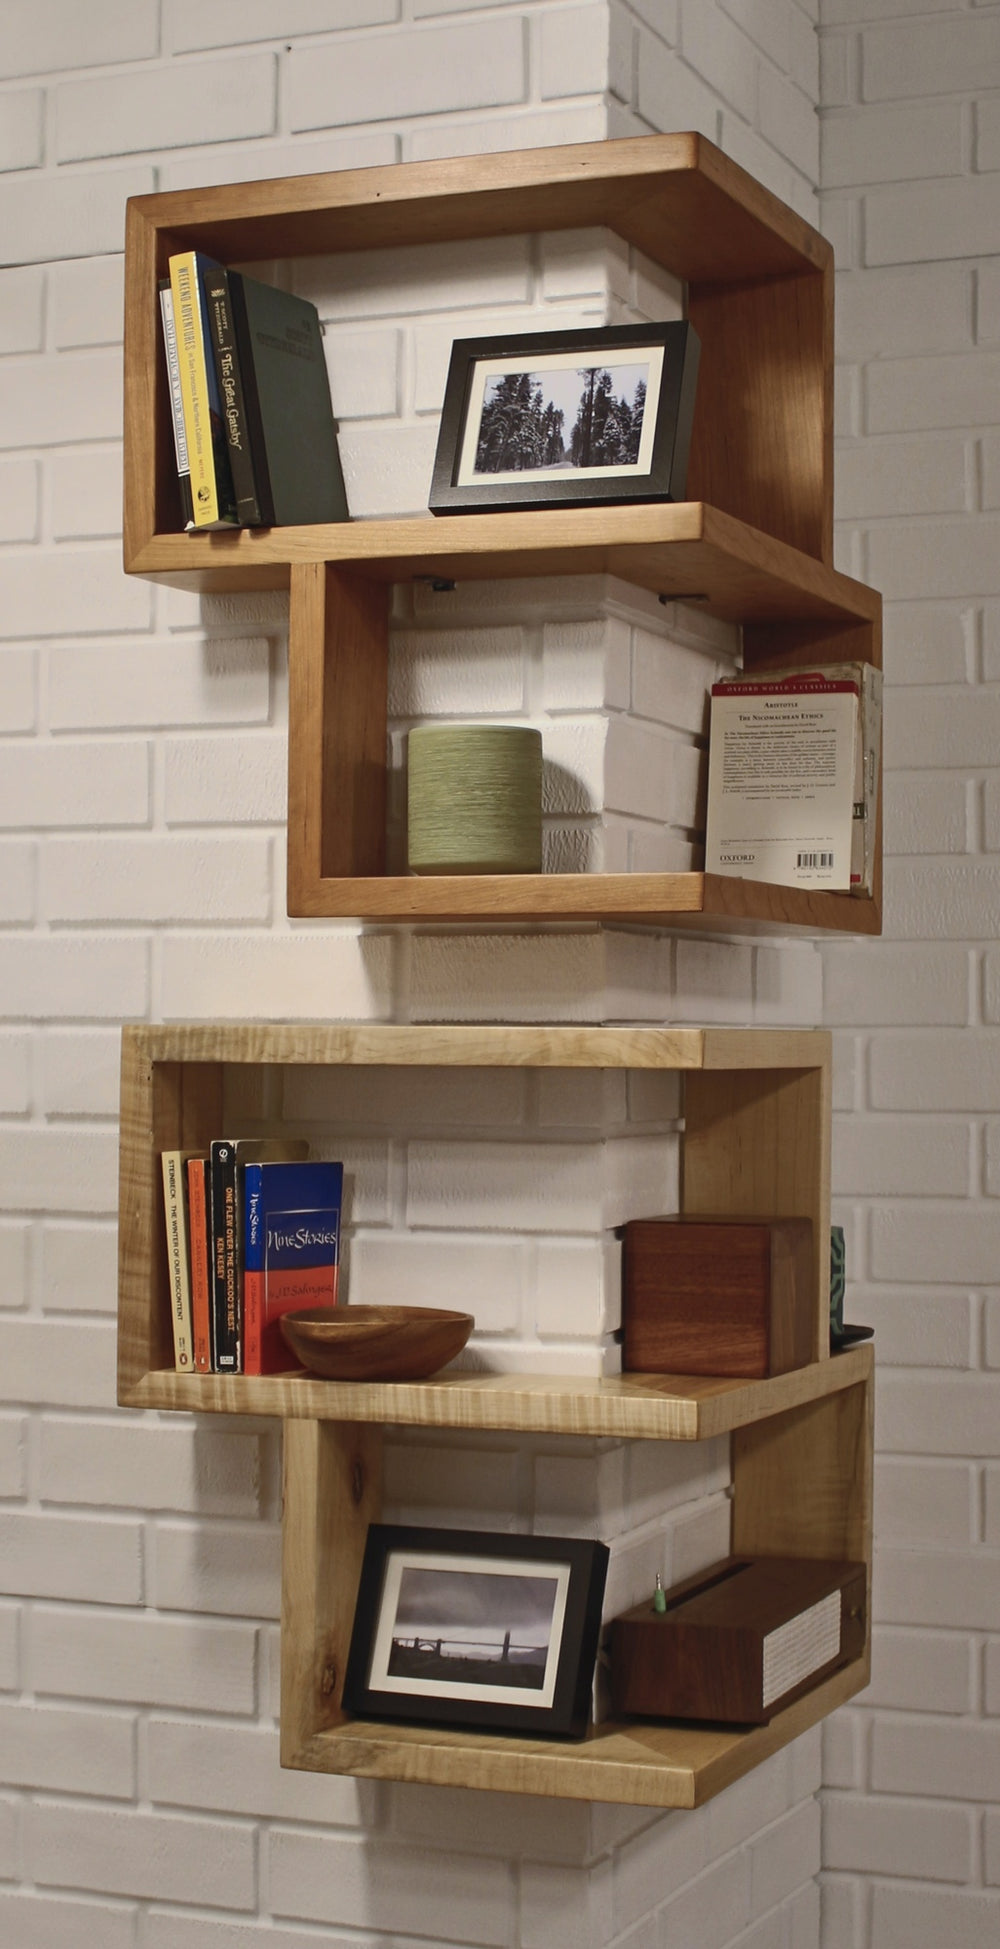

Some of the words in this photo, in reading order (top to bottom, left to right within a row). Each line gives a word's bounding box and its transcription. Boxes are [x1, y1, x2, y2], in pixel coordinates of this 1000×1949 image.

[177, 266, 191, 302] WEEKEND
[180, 303, 196, 351] ADVENTURES
[214, 301, 224, 345] FITZGERALD
[220, 308, 228, 330] SCOTT
[221, 353, 233, 376] The
[222, 377, 236, 408] Great
[226, 409, 242, 450] Gatsby
[752, 713, 799, 721] NICOMACHEAN
[719, 854, 755, 862] OXFORD
[168, 1159, 176, 1200] STEINBECK
[225, 1187, 233, 1204] ONE
[172, 1220, 180, 1247] WINTER
[174, 1249, 180, 1258] OF
[217, 1254, 225, 1280] KESEY
[175, 1276, 183, 1321] DISCONTENT
[227, 1311, 235, 1332] NEST
